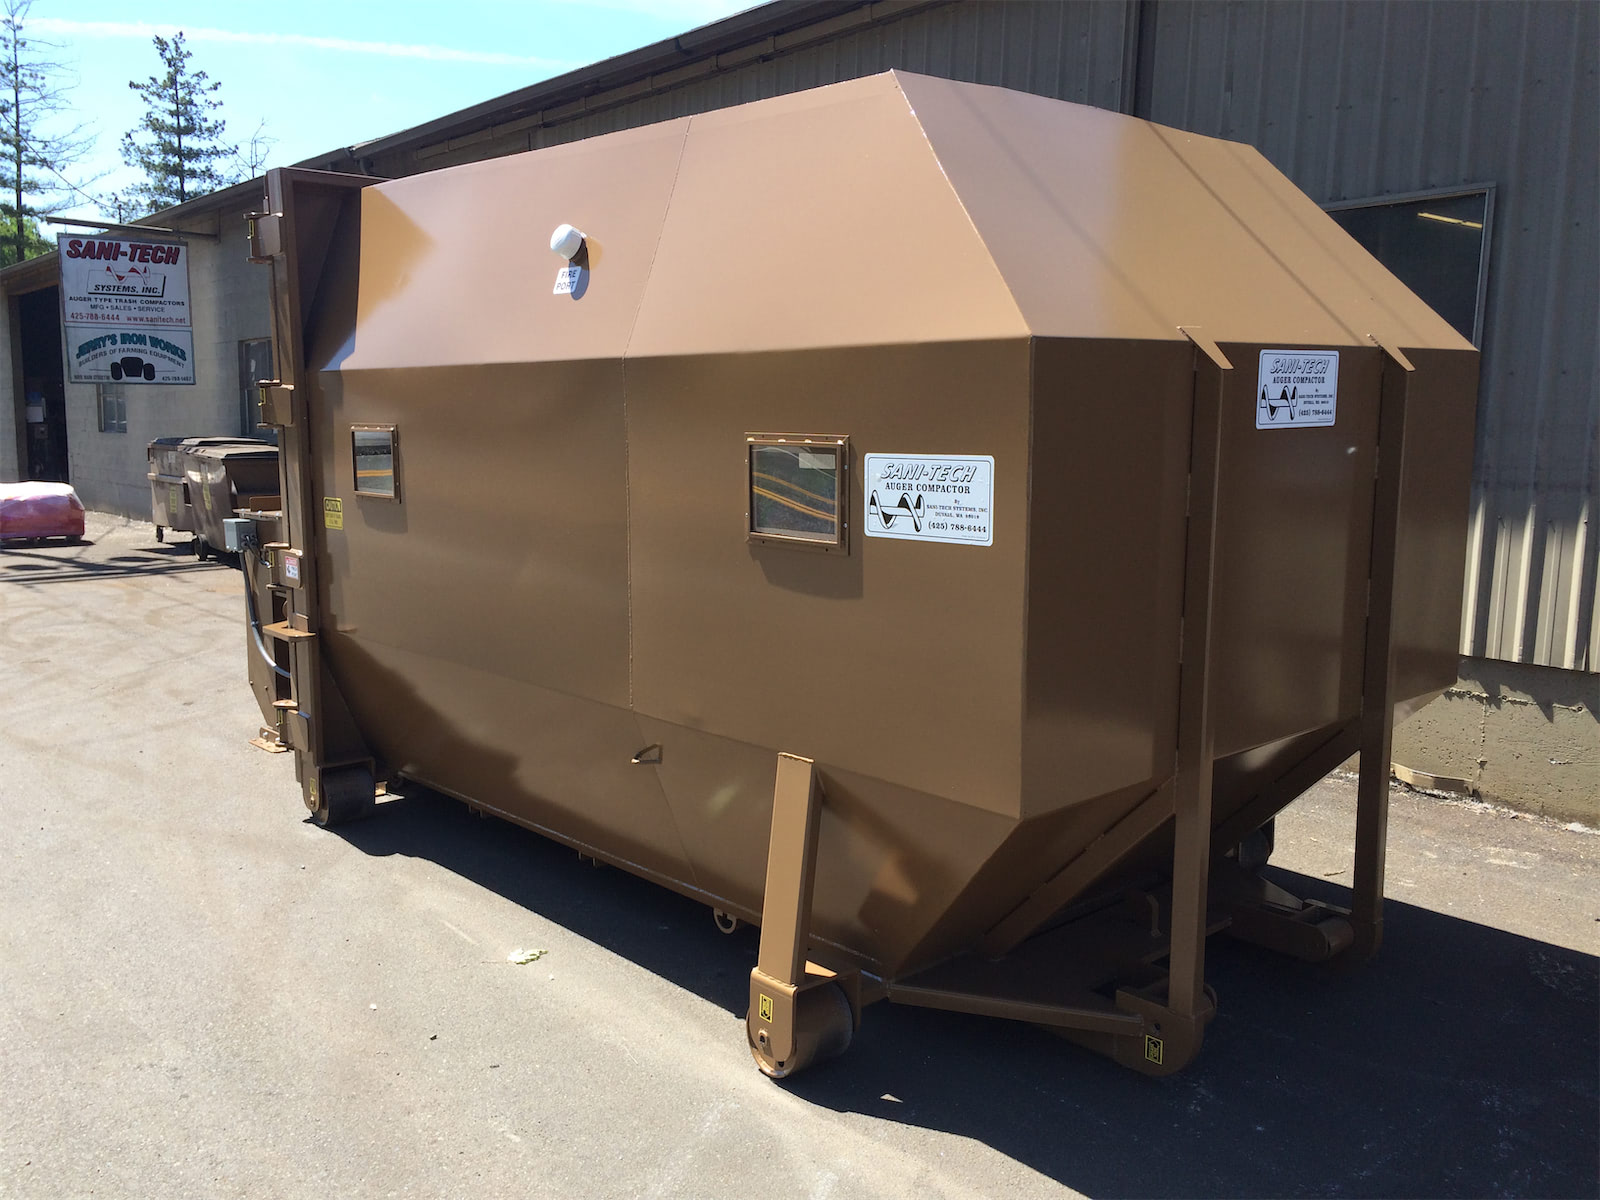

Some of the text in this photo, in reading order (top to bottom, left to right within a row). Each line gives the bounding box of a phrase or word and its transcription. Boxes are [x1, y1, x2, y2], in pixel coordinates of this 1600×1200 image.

[66, 239, 180, 265] SANI-TECH
[561, 269, 577, 278] FIRE
[142, 286, 160, 295] INC.
[556, 281, 576, 290] PORT
[140, 299, 185, 307] COMPACTORS
[71, 312, 186, 324] 425-788-6444 www.sanitech.net
[120, 333, 148, 346] IRON
[148, 335, 187, 361] WORKS
[79, 349, 108, 367] BUILDERS
[118, 347, 148, 355] FARMING
[149, 350, 185, 369] EQUIPMENT
[1270, 357, 1330, 374] SANI-TECH
[1273, 376, 1325, 384] AUGER COMPACTOR
[880, 462, 978, 483] SANI-TECH
[885, 482, 971, 494] AUGER COMPACTOR
[928, 520, 986, 533] (425) 788-6444
